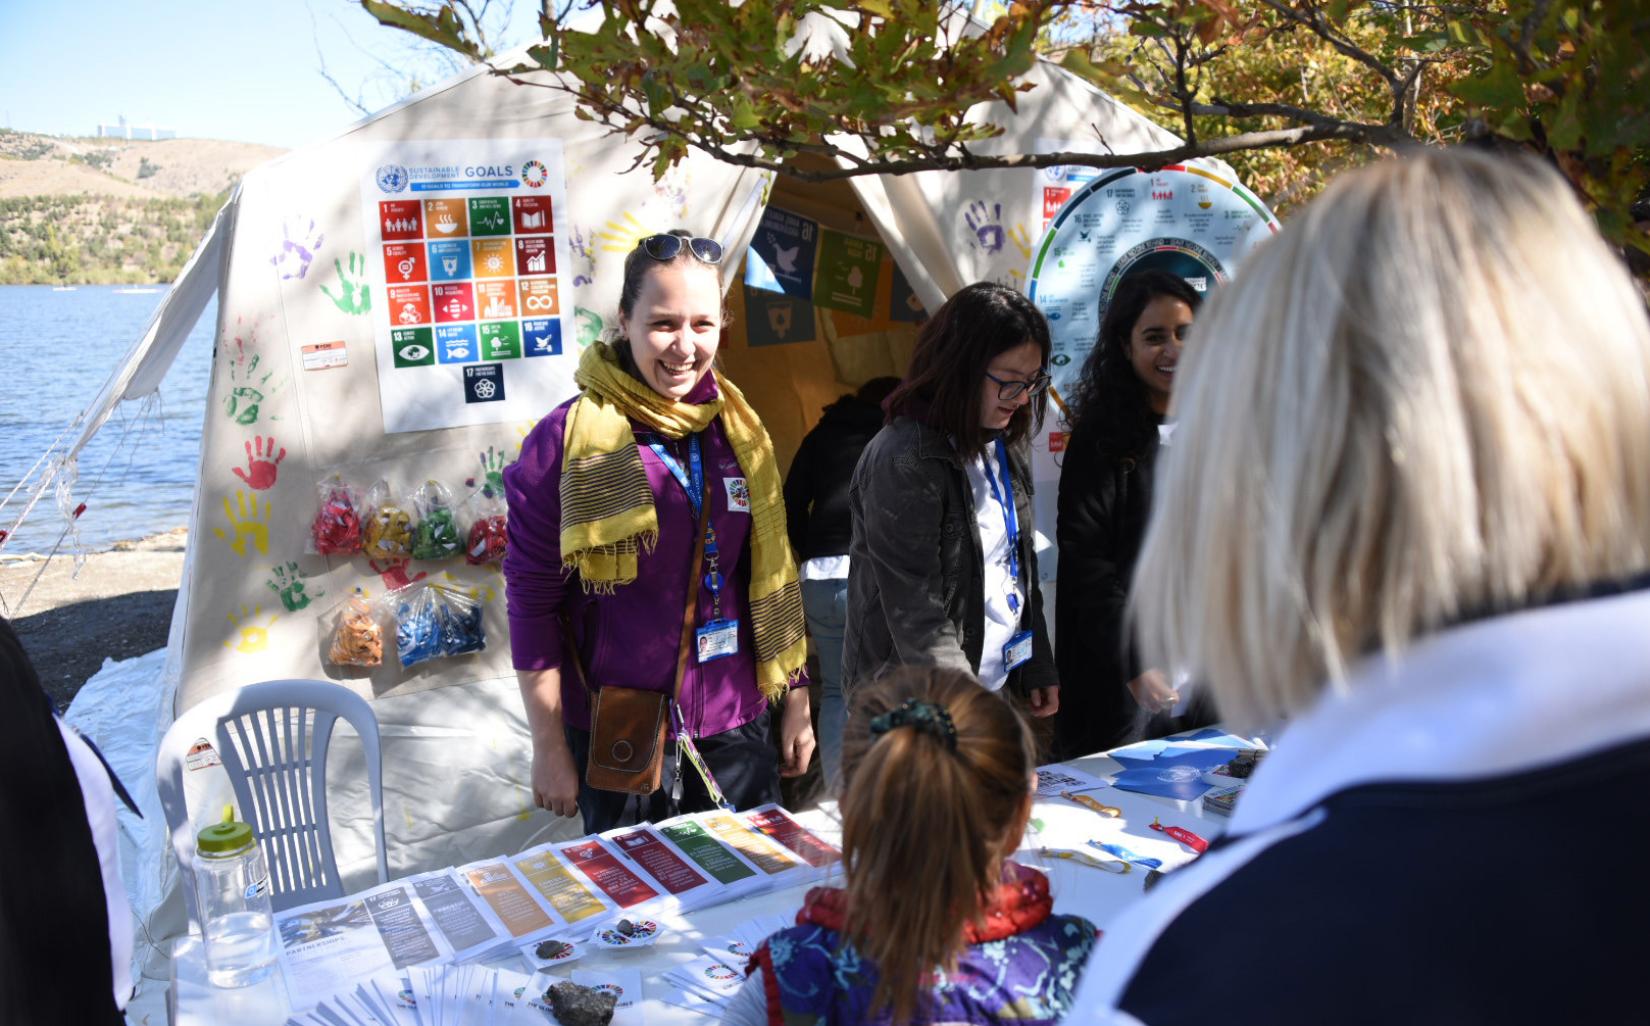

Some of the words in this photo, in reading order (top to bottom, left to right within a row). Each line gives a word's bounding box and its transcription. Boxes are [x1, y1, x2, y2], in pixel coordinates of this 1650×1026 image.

[408, 166, 459, 174] SUSTAINABLE
[464, 165, 513, 178] GOALS
[428, 202, 434, 211] 2
[471, 200, 478, 209] 3
[515, 198, 523, 208] 4
[383, 204, 389, 213] 1
[518, 240, 525, 249] 8
[386, 247, 393, 257] 5
[389, 289, 396, 299] 9
[434, 286, 444, 296] 10
[438, 328, 448, 338] 14
[481, 324, 491, 335] 15
[394, 331, 403, 342] 13
[466, 367, 474, 378] 17
[285, 936, 345, 956] PARTNERSHIPS
